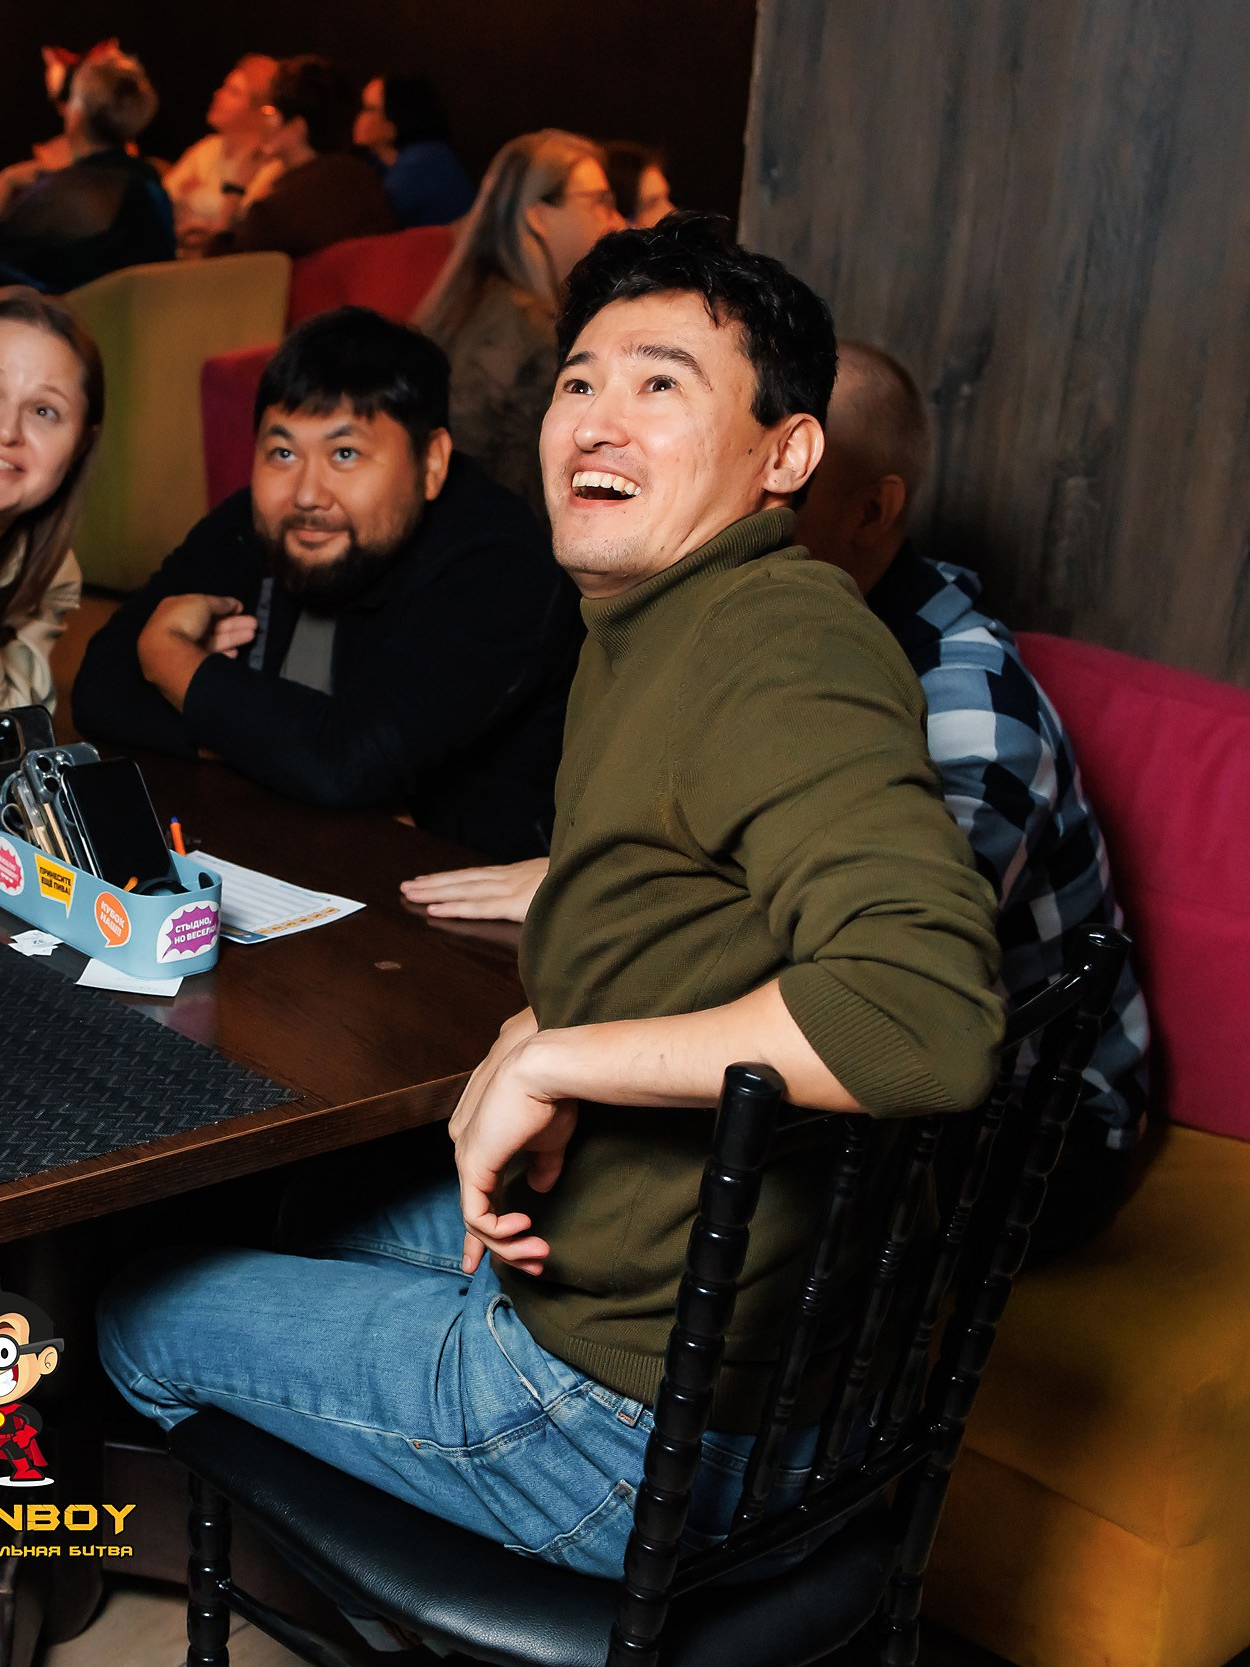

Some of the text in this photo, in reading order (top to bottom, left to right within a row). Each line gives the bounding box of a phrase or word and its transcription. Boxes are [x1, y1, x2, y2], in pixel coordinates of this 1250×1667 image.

[40, 867, 71, 886] ПРИНЕСИТЕ
[101, 901, 125, 928] КУБОК
[175, 917, 212, 933] СТЫДНО,
[174, 934, 186, 945] НО
